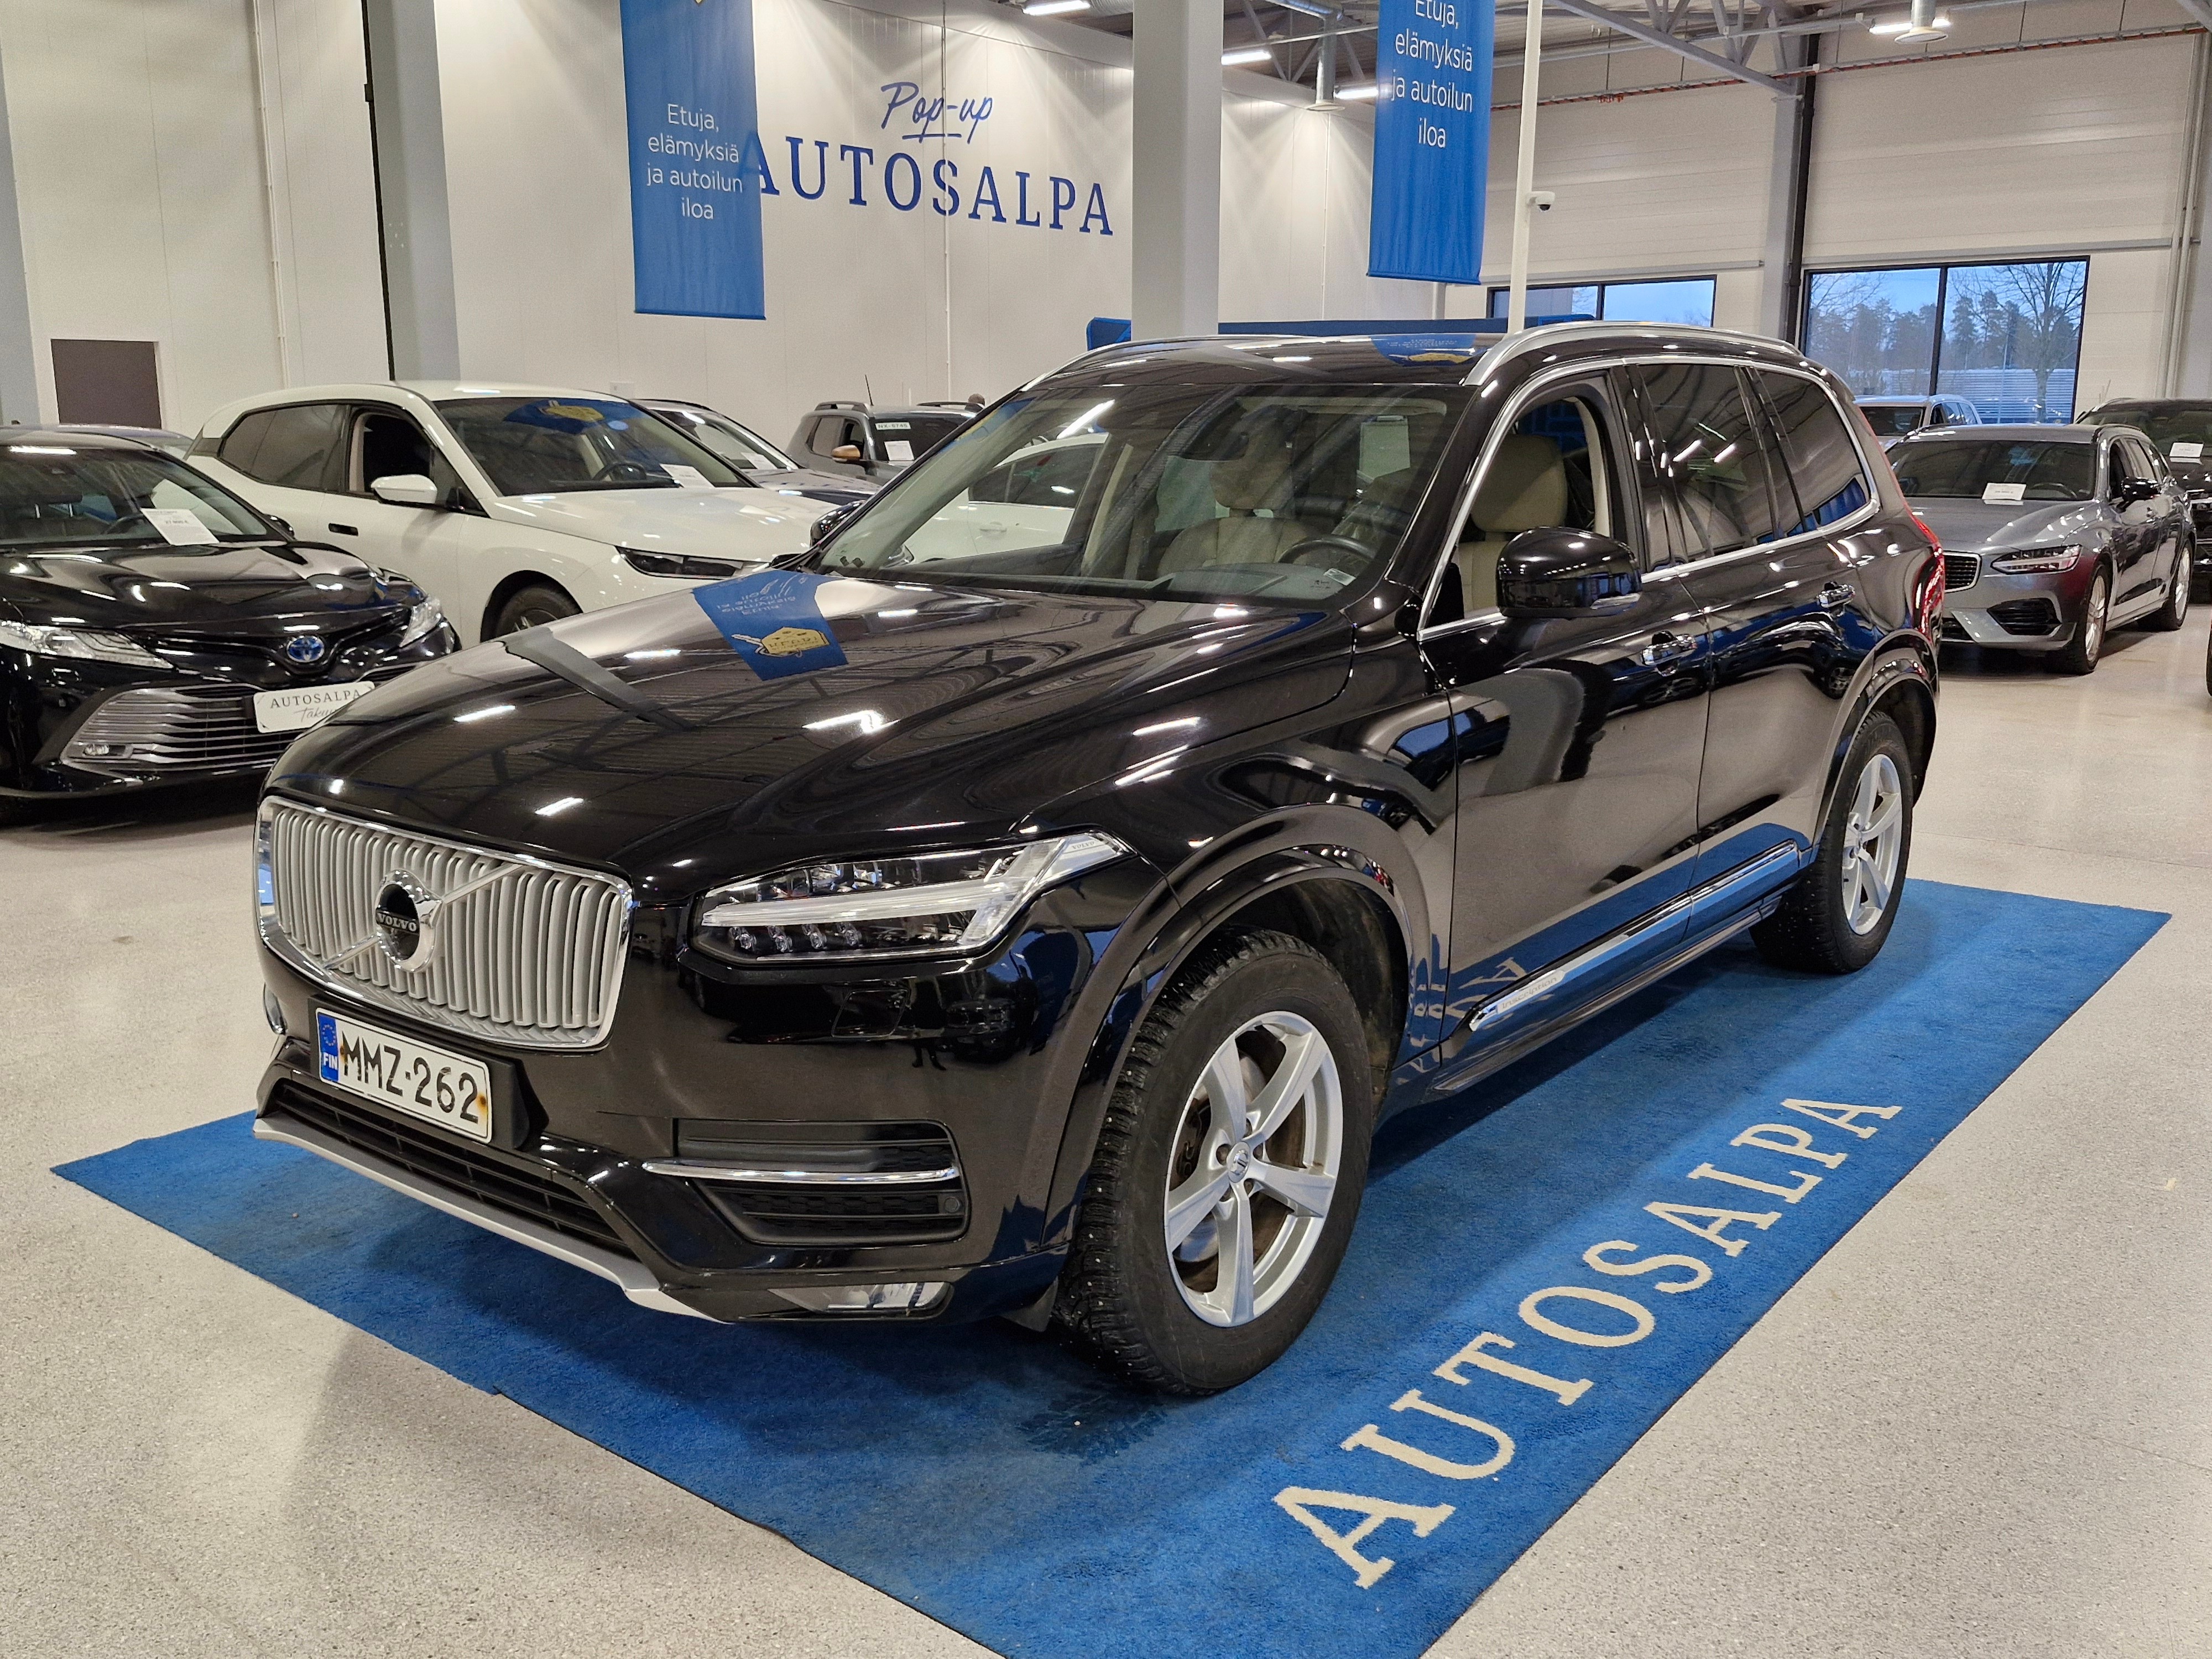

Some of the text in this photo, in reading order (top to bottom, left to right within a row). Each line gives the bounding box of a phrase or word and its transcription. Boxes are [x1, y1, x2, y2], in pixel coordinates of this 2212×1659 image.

[1395, 28, 1472, 72] elämyksiä
[1391, 69, 1473, 113] ja autoilun
[667, 103, 719, 132] Etuja,
[880, 81, 993, 144] Pop-up
[648, 133, 739, 163] elämyksiä
[1418, 117, 1446, 148] iloa
[646, 163, 743, 194] ja autoilun
[737, 129, 1114, 237] AUTOSALPA
[681, 197, 714, 220] iloa
[270, 689, 361, 708] AUTOSALPA
[294, 707, 332, 722] Taku
[1072, 841, 1095, 849] VOLVO
[377, 912, 417, 932] VOLVO
[1502, 977, 1557, 1009] Inscription
[323, 1052, 338, 1071] FIN
[342, 1030, 478, 1124] MMZ-262
[1272, 1097, 1903, 1589] AUTOSALPA
